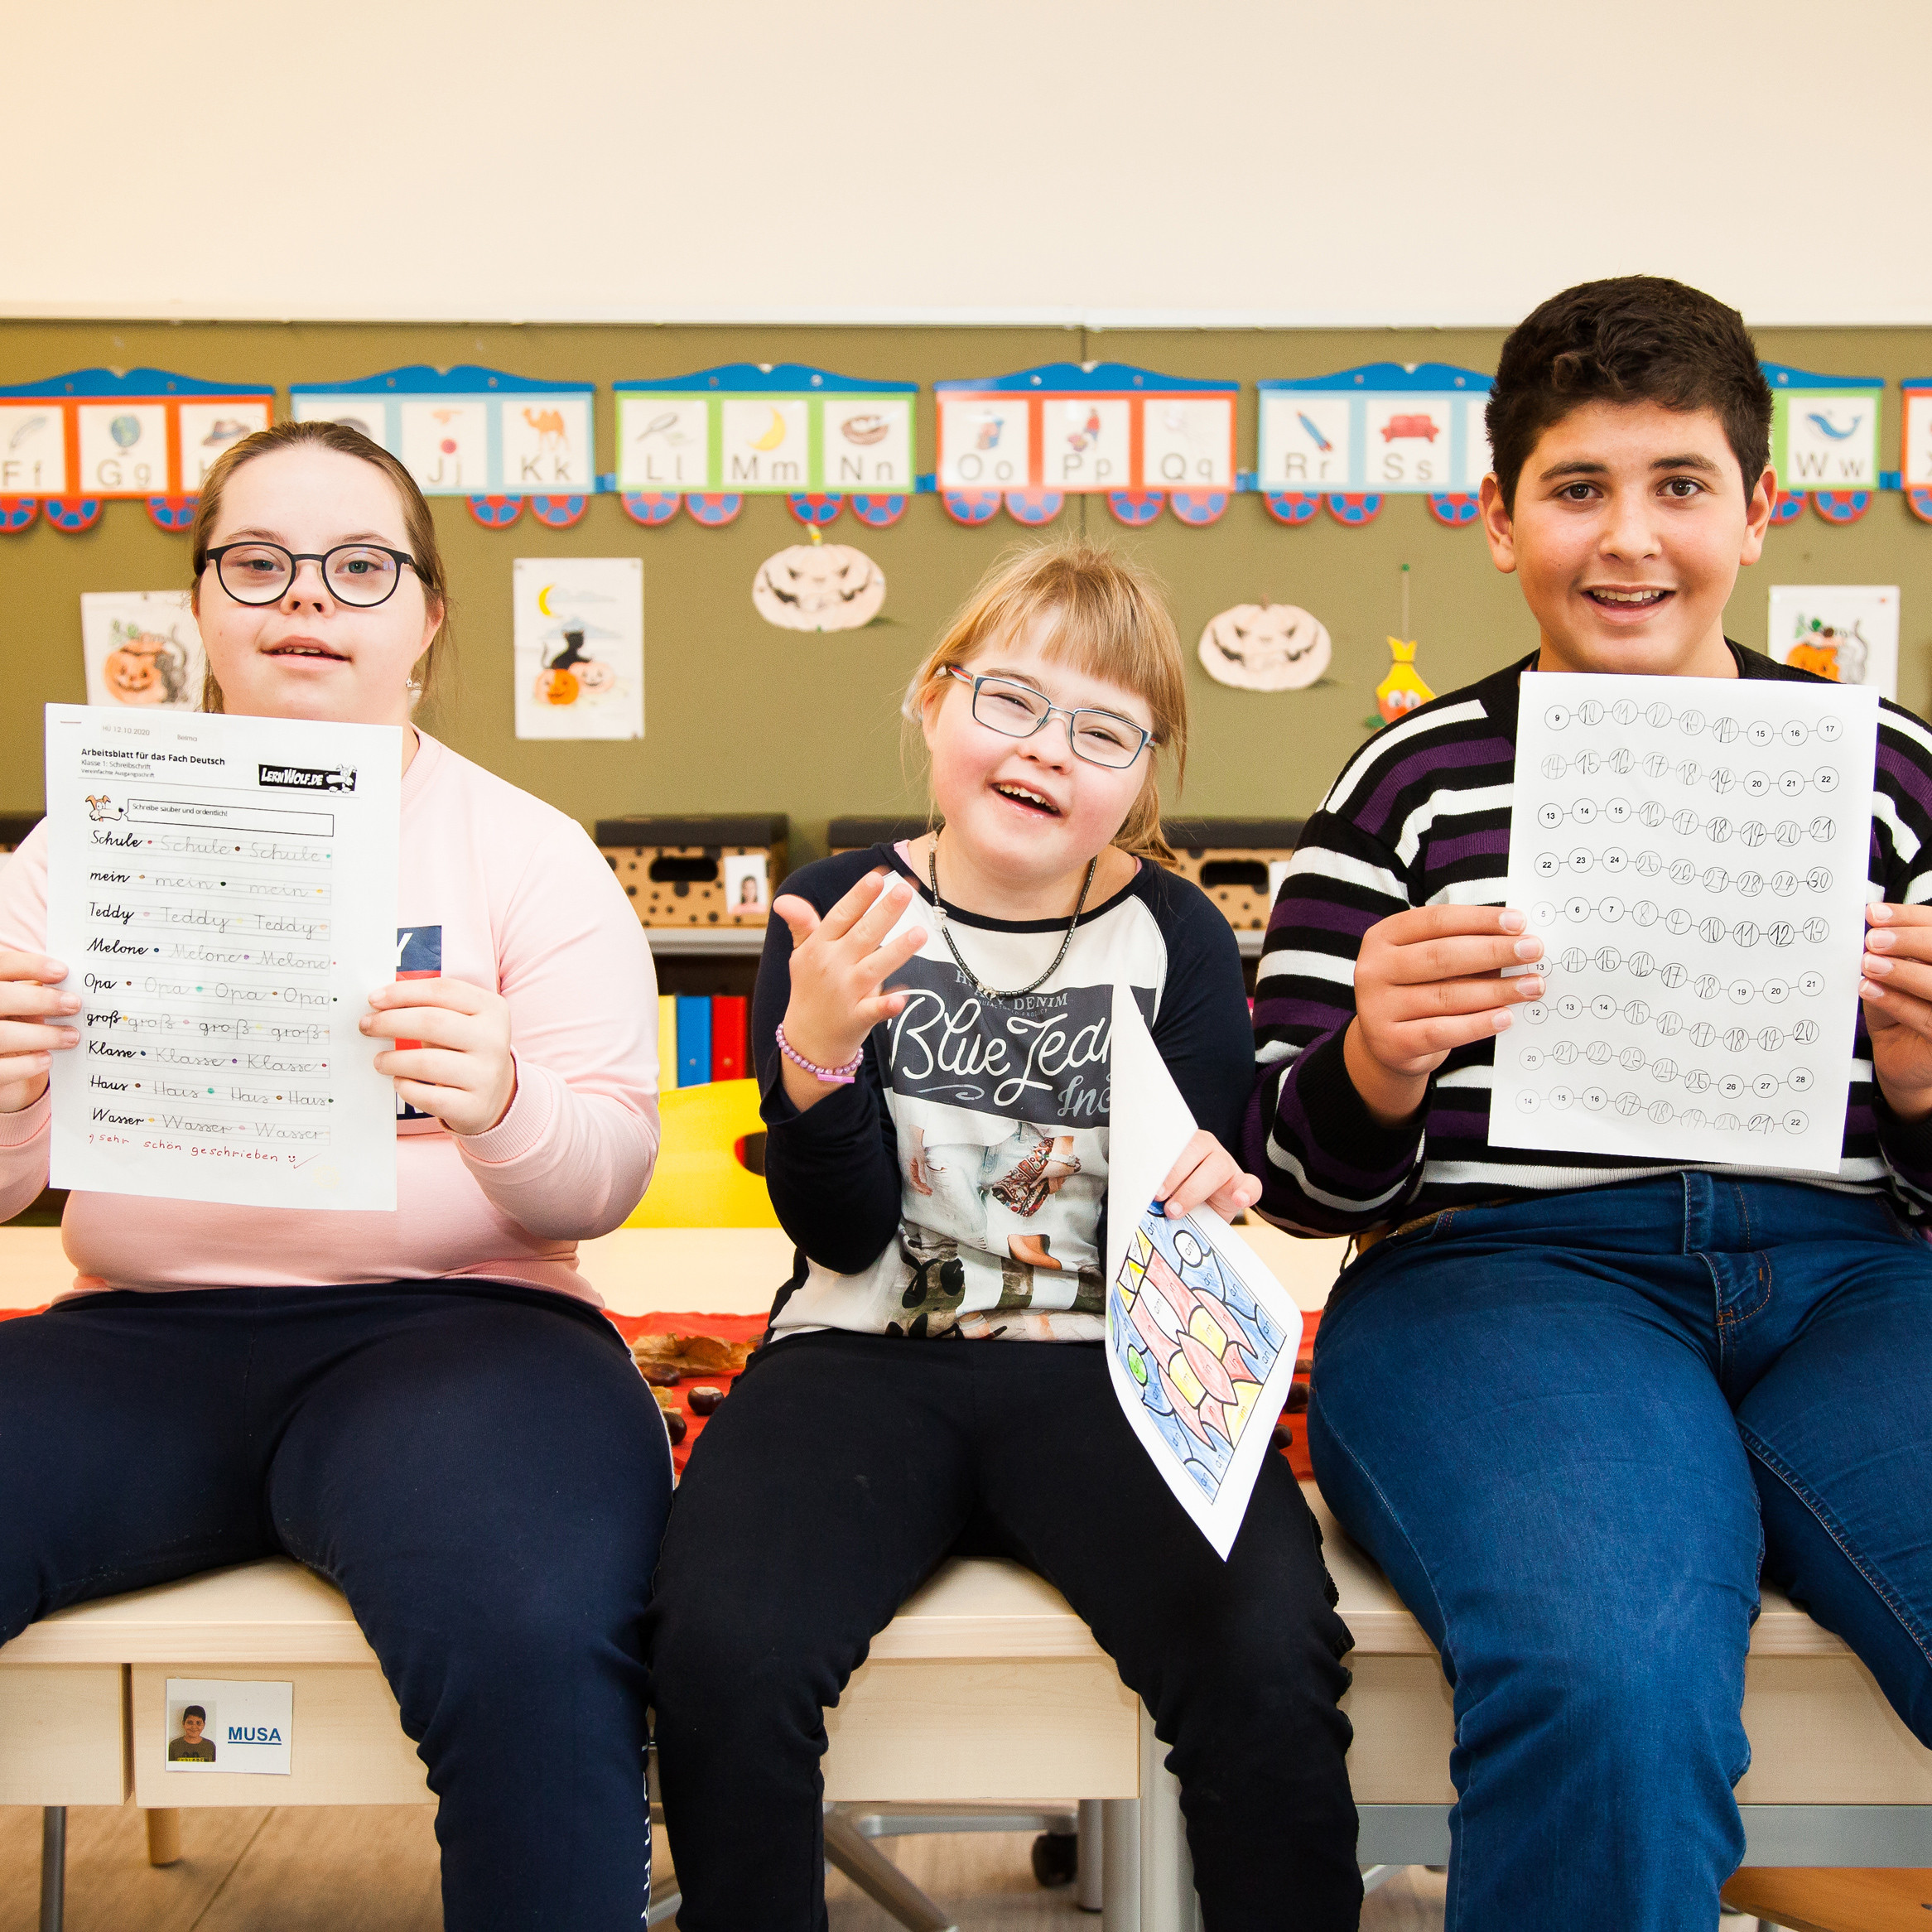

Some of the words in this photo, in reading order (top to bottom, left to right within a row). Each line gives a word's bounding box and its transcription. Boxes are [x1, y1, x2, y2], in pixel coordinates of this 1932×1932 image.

[81, 749, 134, 759] Arbeitsblatt
[136, 750, 149, 760] für
[151, 752, 166, 761] das
[168, 754, 188, 764] Fach
[190, 755, 225, 765] Deutsch
[81, 759, 101, 767] Klasse
[109, 761, 152, 770] Schreibschrift
[114, 770, 156, 778] Ausgangsschrift
[1821, 775, 1831, 783] 22
[132, 803, 159, 812] Schreibe
[195, 808, 229, 817] ordentlich!
[90, 830, 143, 848] Schule
[89, 870, 131, 883] mein
[89, 901, 135, 926] Teddy
[159, 906, 230, 934] Teddy
[253, 914, 318, 941] Teddy
[86, 937, 149, 956] Melone
[84, 972, 118, 994] Opa
[215, 982, 267, 1005] Opa
[283, 987, 331, 1009] Opa
[1771, 987, 1781, 995] 20
[1014, 992, 1068, 1010] DENIM
[86, 1009, 123, 1029] groß
[199, 1019, 252, 1040] groß
[271, 1024, 321, 1045] groß
[887, 988, 1011, 1080] Blue
[88, 1040, 137, 1058] Klasse
[90, 1075, 129, 1091] Haus
[1590, 1095, 1600, 1103] 16
[92, 1106, 145, 1126] Wasser
[99, 1133, 130, 1145] sehr
[142, 1139, 182, 1151] schön
[190, 1146, 278, 1163] geschrieben
[1147, 1221, 1158, 1236] an
[1185, 1239, 1197, 1256] am
[1203, 1272, 1214, 1286] an
[1230, 1284, 1240, 1297] an
[1154, 1298, 1164, 1315] am
[1264, 1320, 1273, 1335] an
[1262, 1350, 1271, 1365] an
[1216, 1454, 1225, 1468] an
[229, 1726, 282, 1742] MUSA
